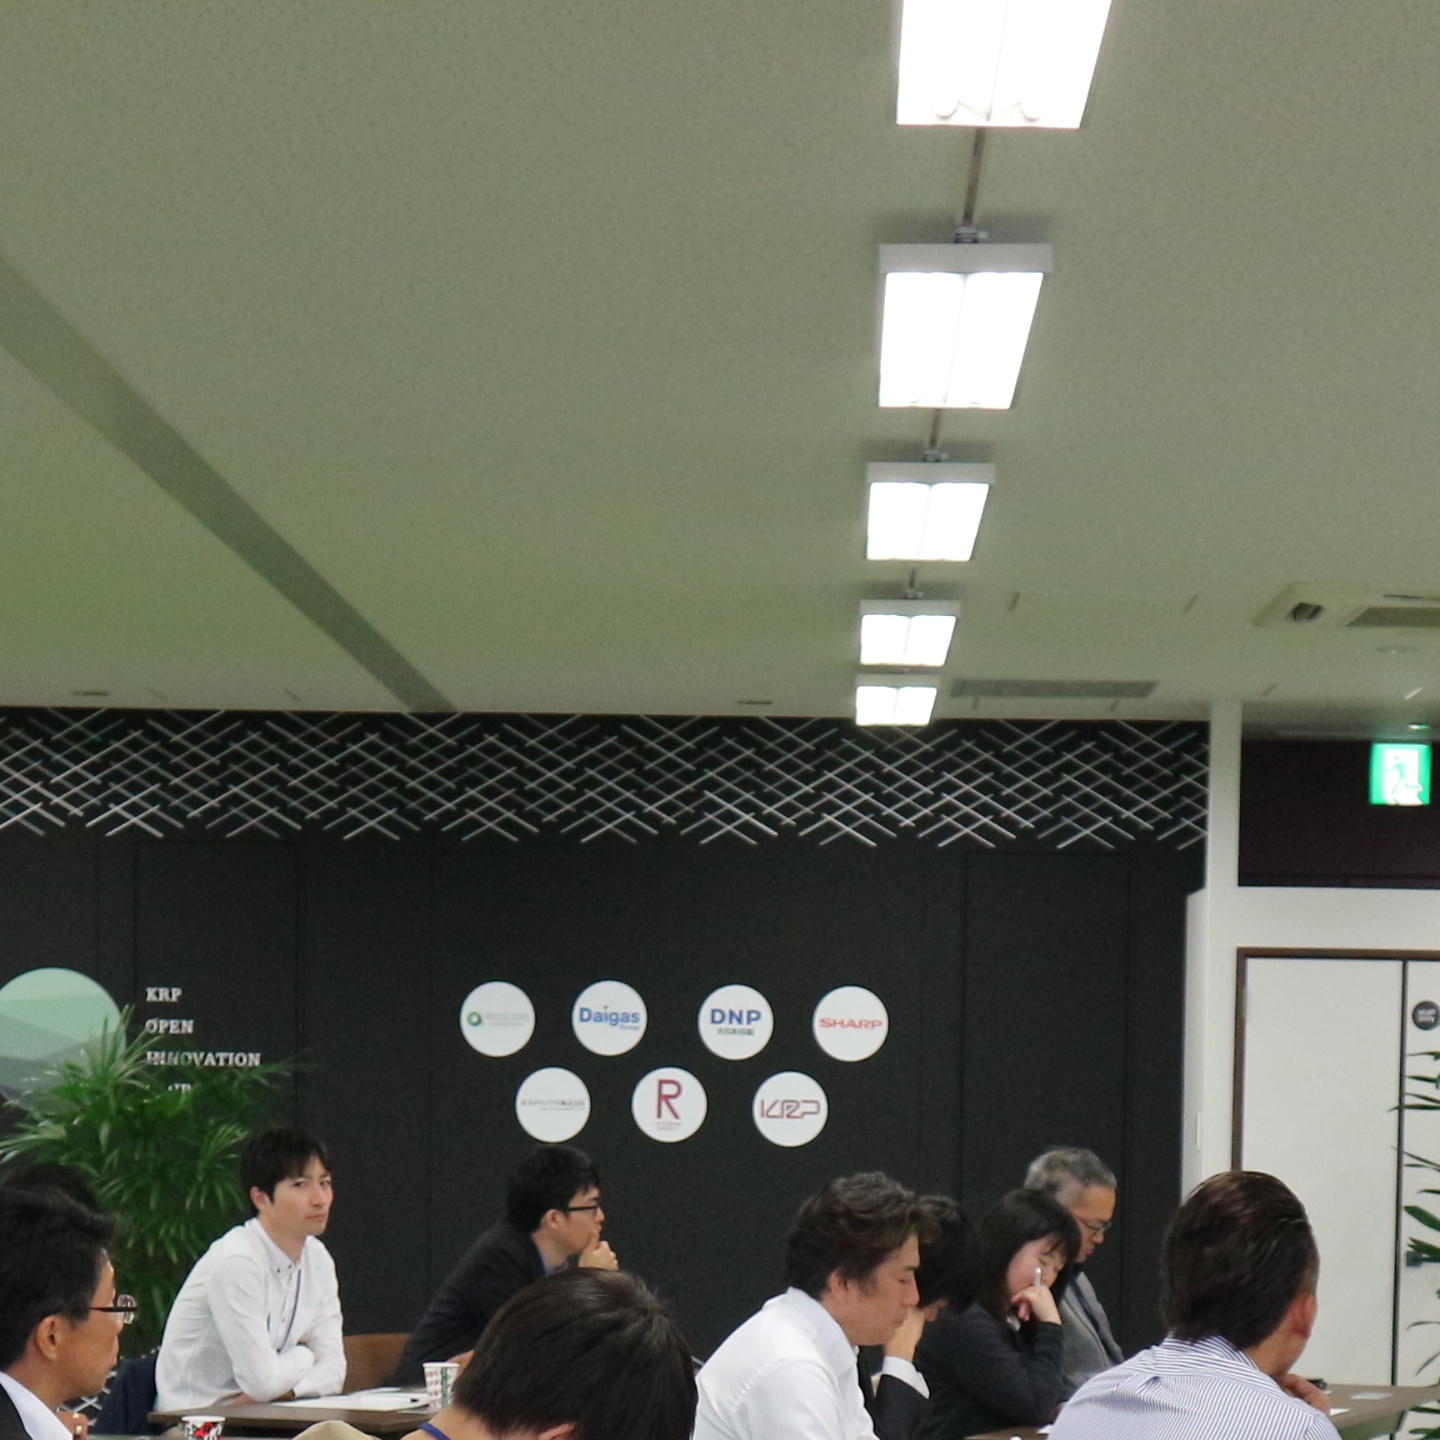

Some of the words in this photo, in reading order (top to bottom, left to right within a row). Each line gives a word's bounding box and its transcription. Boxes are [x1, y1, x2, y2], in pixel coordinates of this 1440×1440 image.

[145, 987, 182, 1002] KRP
[578, 1005, 641, 1026] Daigas
[710, 1008, 762, 1025] DNP
[819, 1017, 883, 1030] SHARP
[144, 1018, 195, 1034] OPEN
[656, 1079, 682, 1119] R
